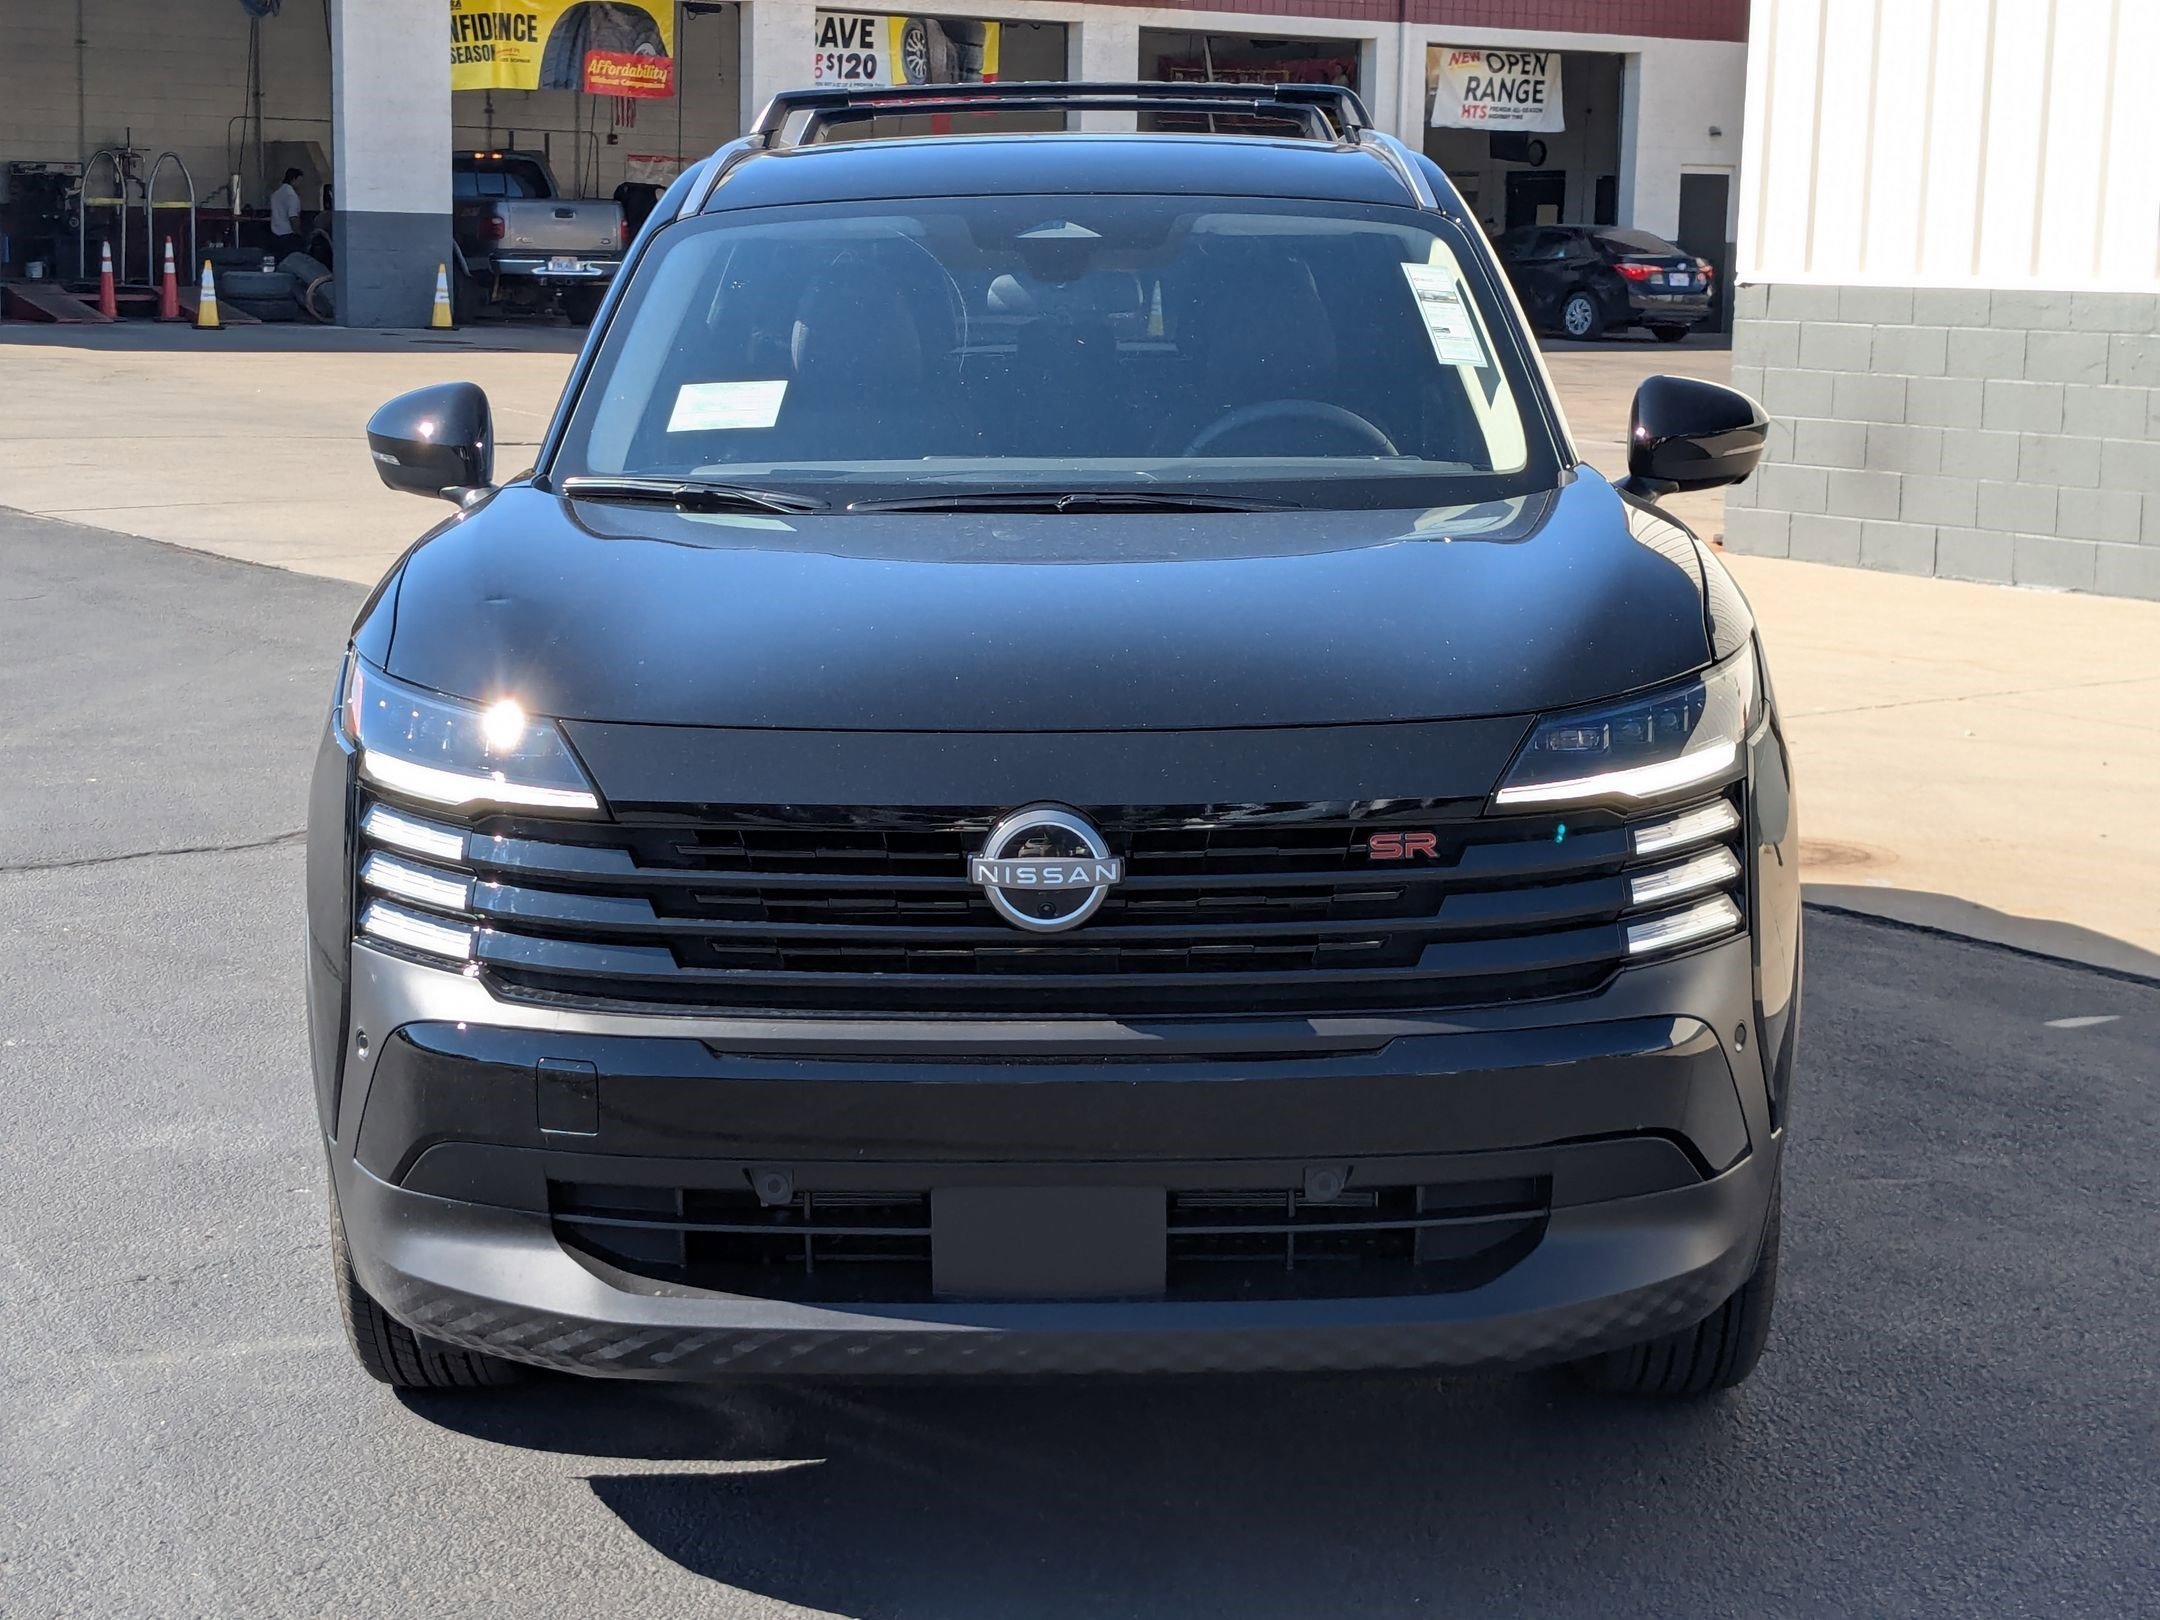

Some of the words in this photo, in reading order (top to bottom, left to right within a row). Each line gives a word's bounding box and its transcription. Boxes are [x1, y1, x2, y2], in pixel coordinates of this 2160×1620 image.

[816, 16, 875, 49] AVE
[588, 59, 668, 83] Affordability
[826, 53, 878, 80] $120
[1449, 52, 1481, 66] NEW
[1485, 52, 1548, 77] OPEN
[1464, 76, 1546, 104] RANGE
[1461, 103, 1488, 120] HTS
[1369, 832, 1440, 860] SR
[977, 863, 1118, 885] NISSAN
